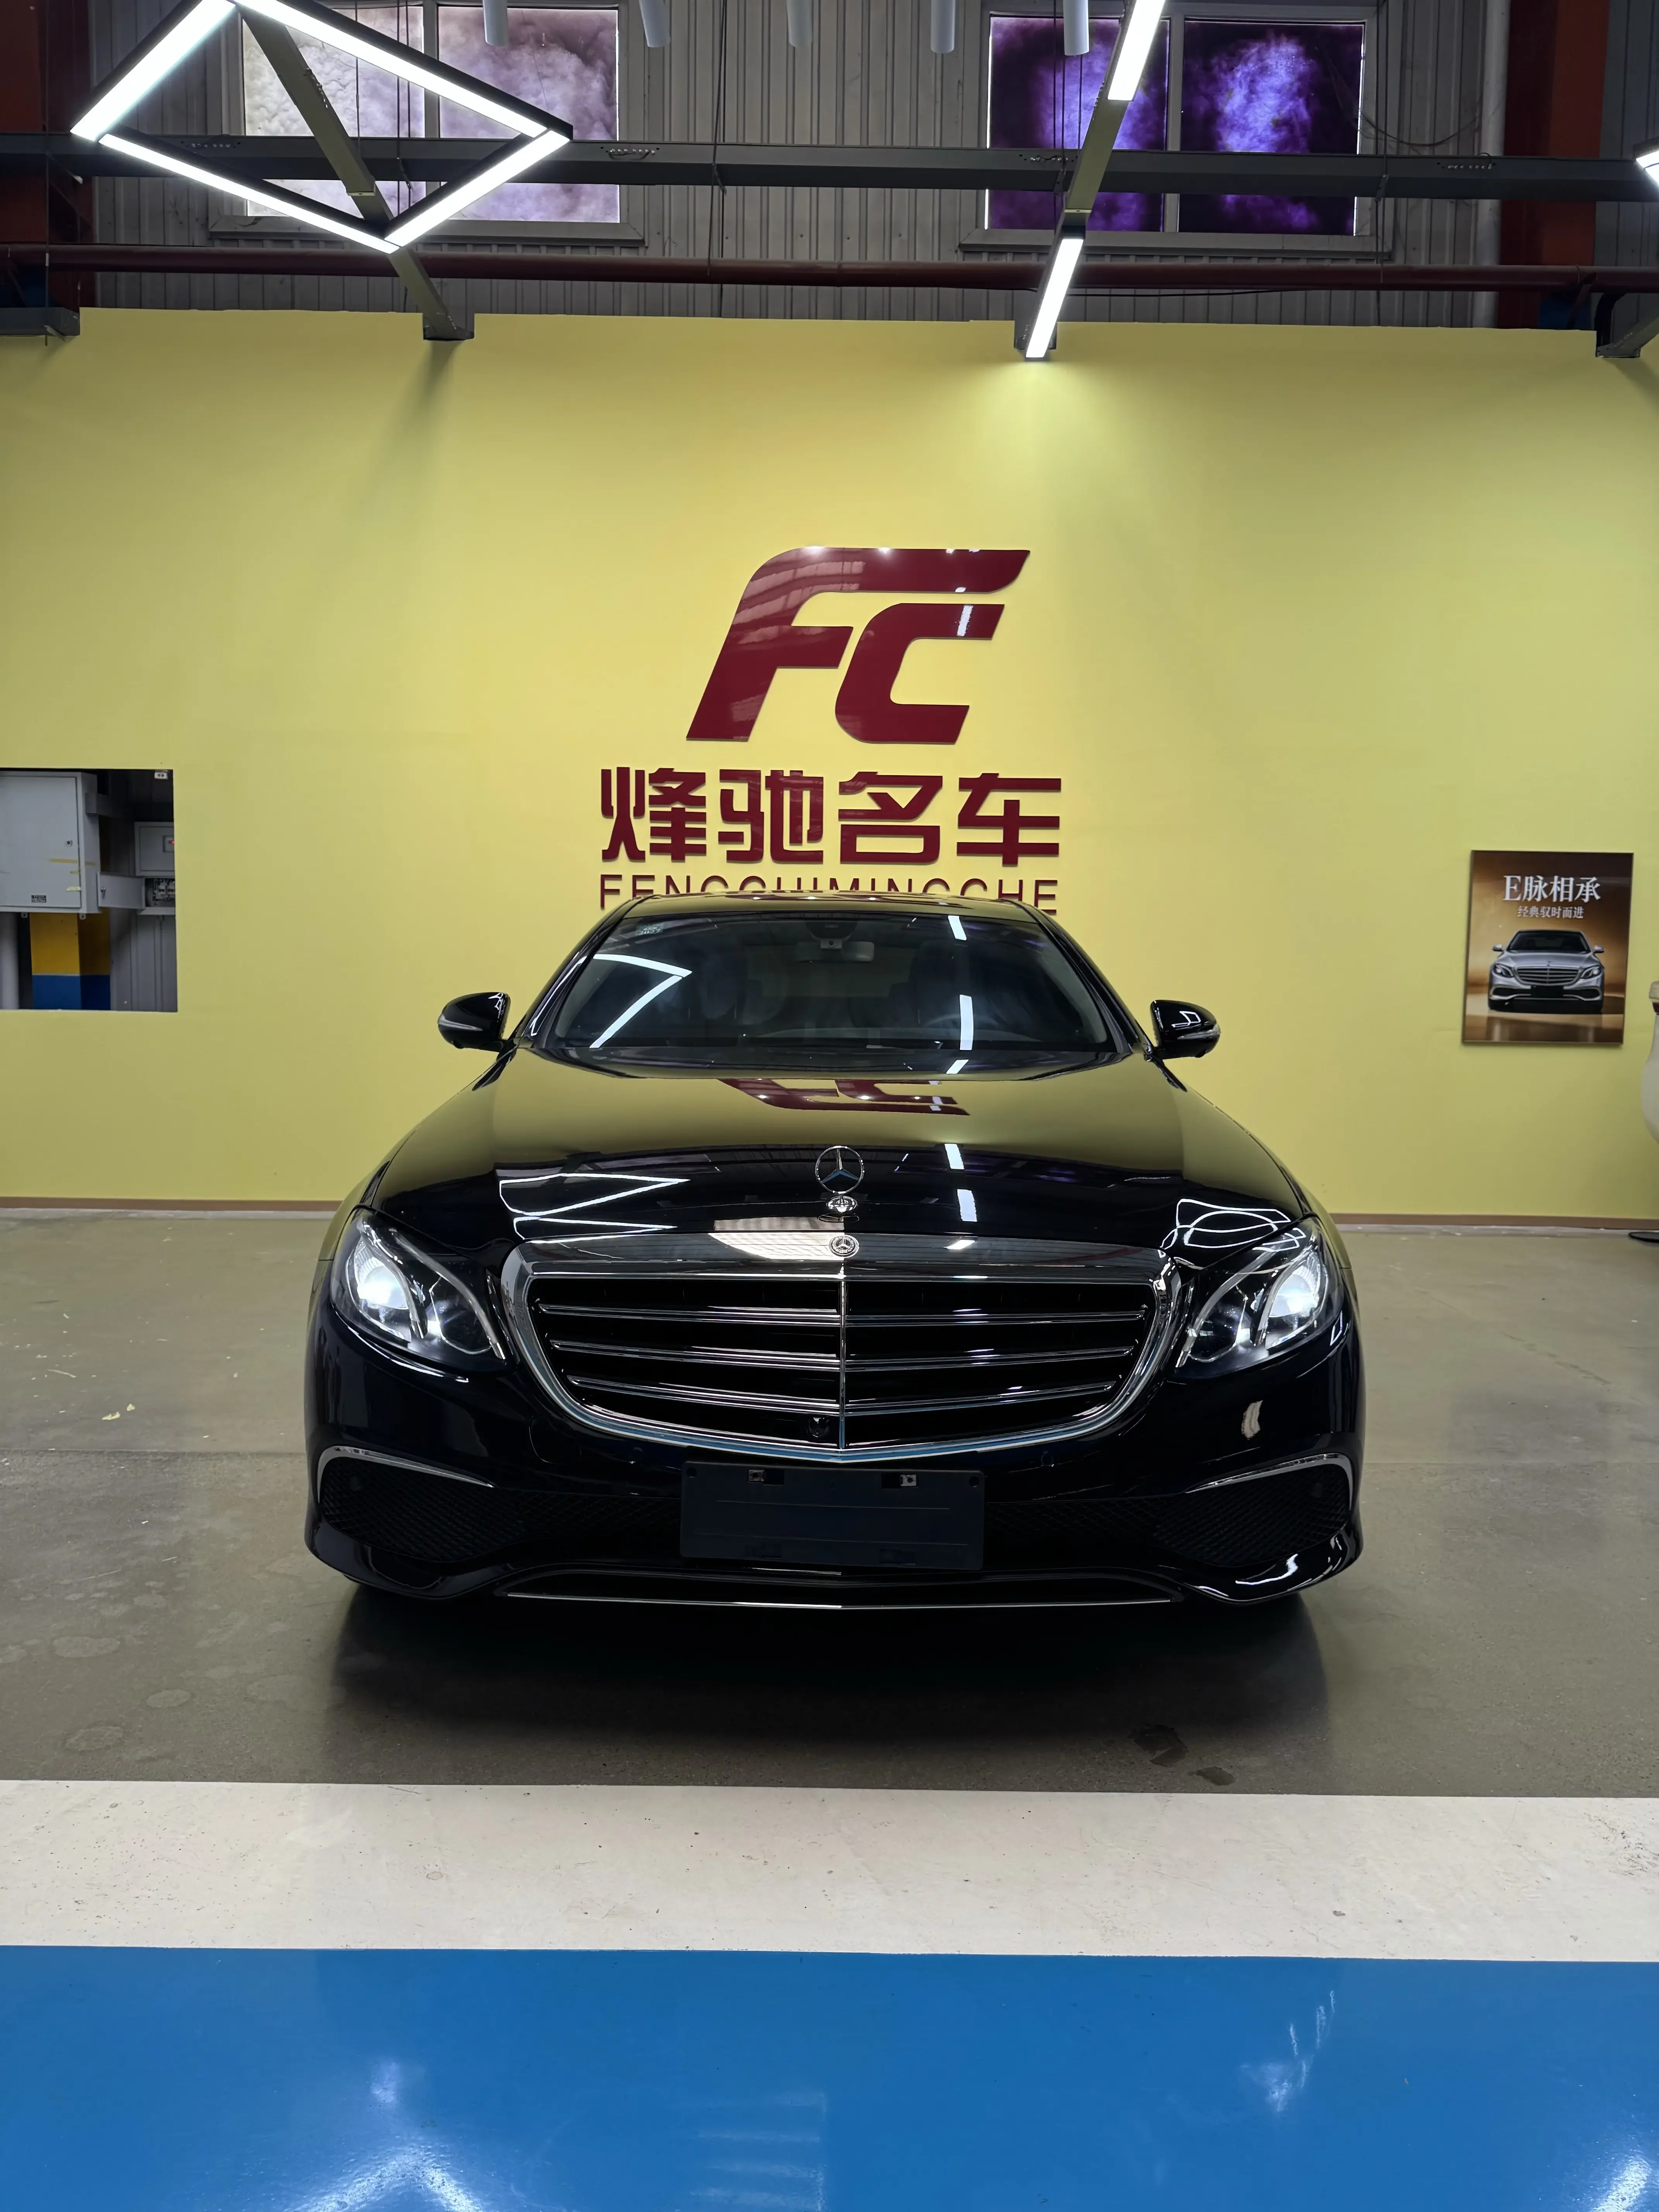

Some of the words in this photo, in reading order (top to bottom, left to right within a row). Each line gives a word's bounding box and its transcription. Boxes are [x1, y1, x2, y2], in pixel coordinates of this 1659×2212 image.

[686, 546, 1030, 744] FC
[601, 767, 1061, 867] 烽驰名车
[1503, 875, 1601, 903] E脉相承
[1517, 905, 1584, 919] 经典驭时而进
